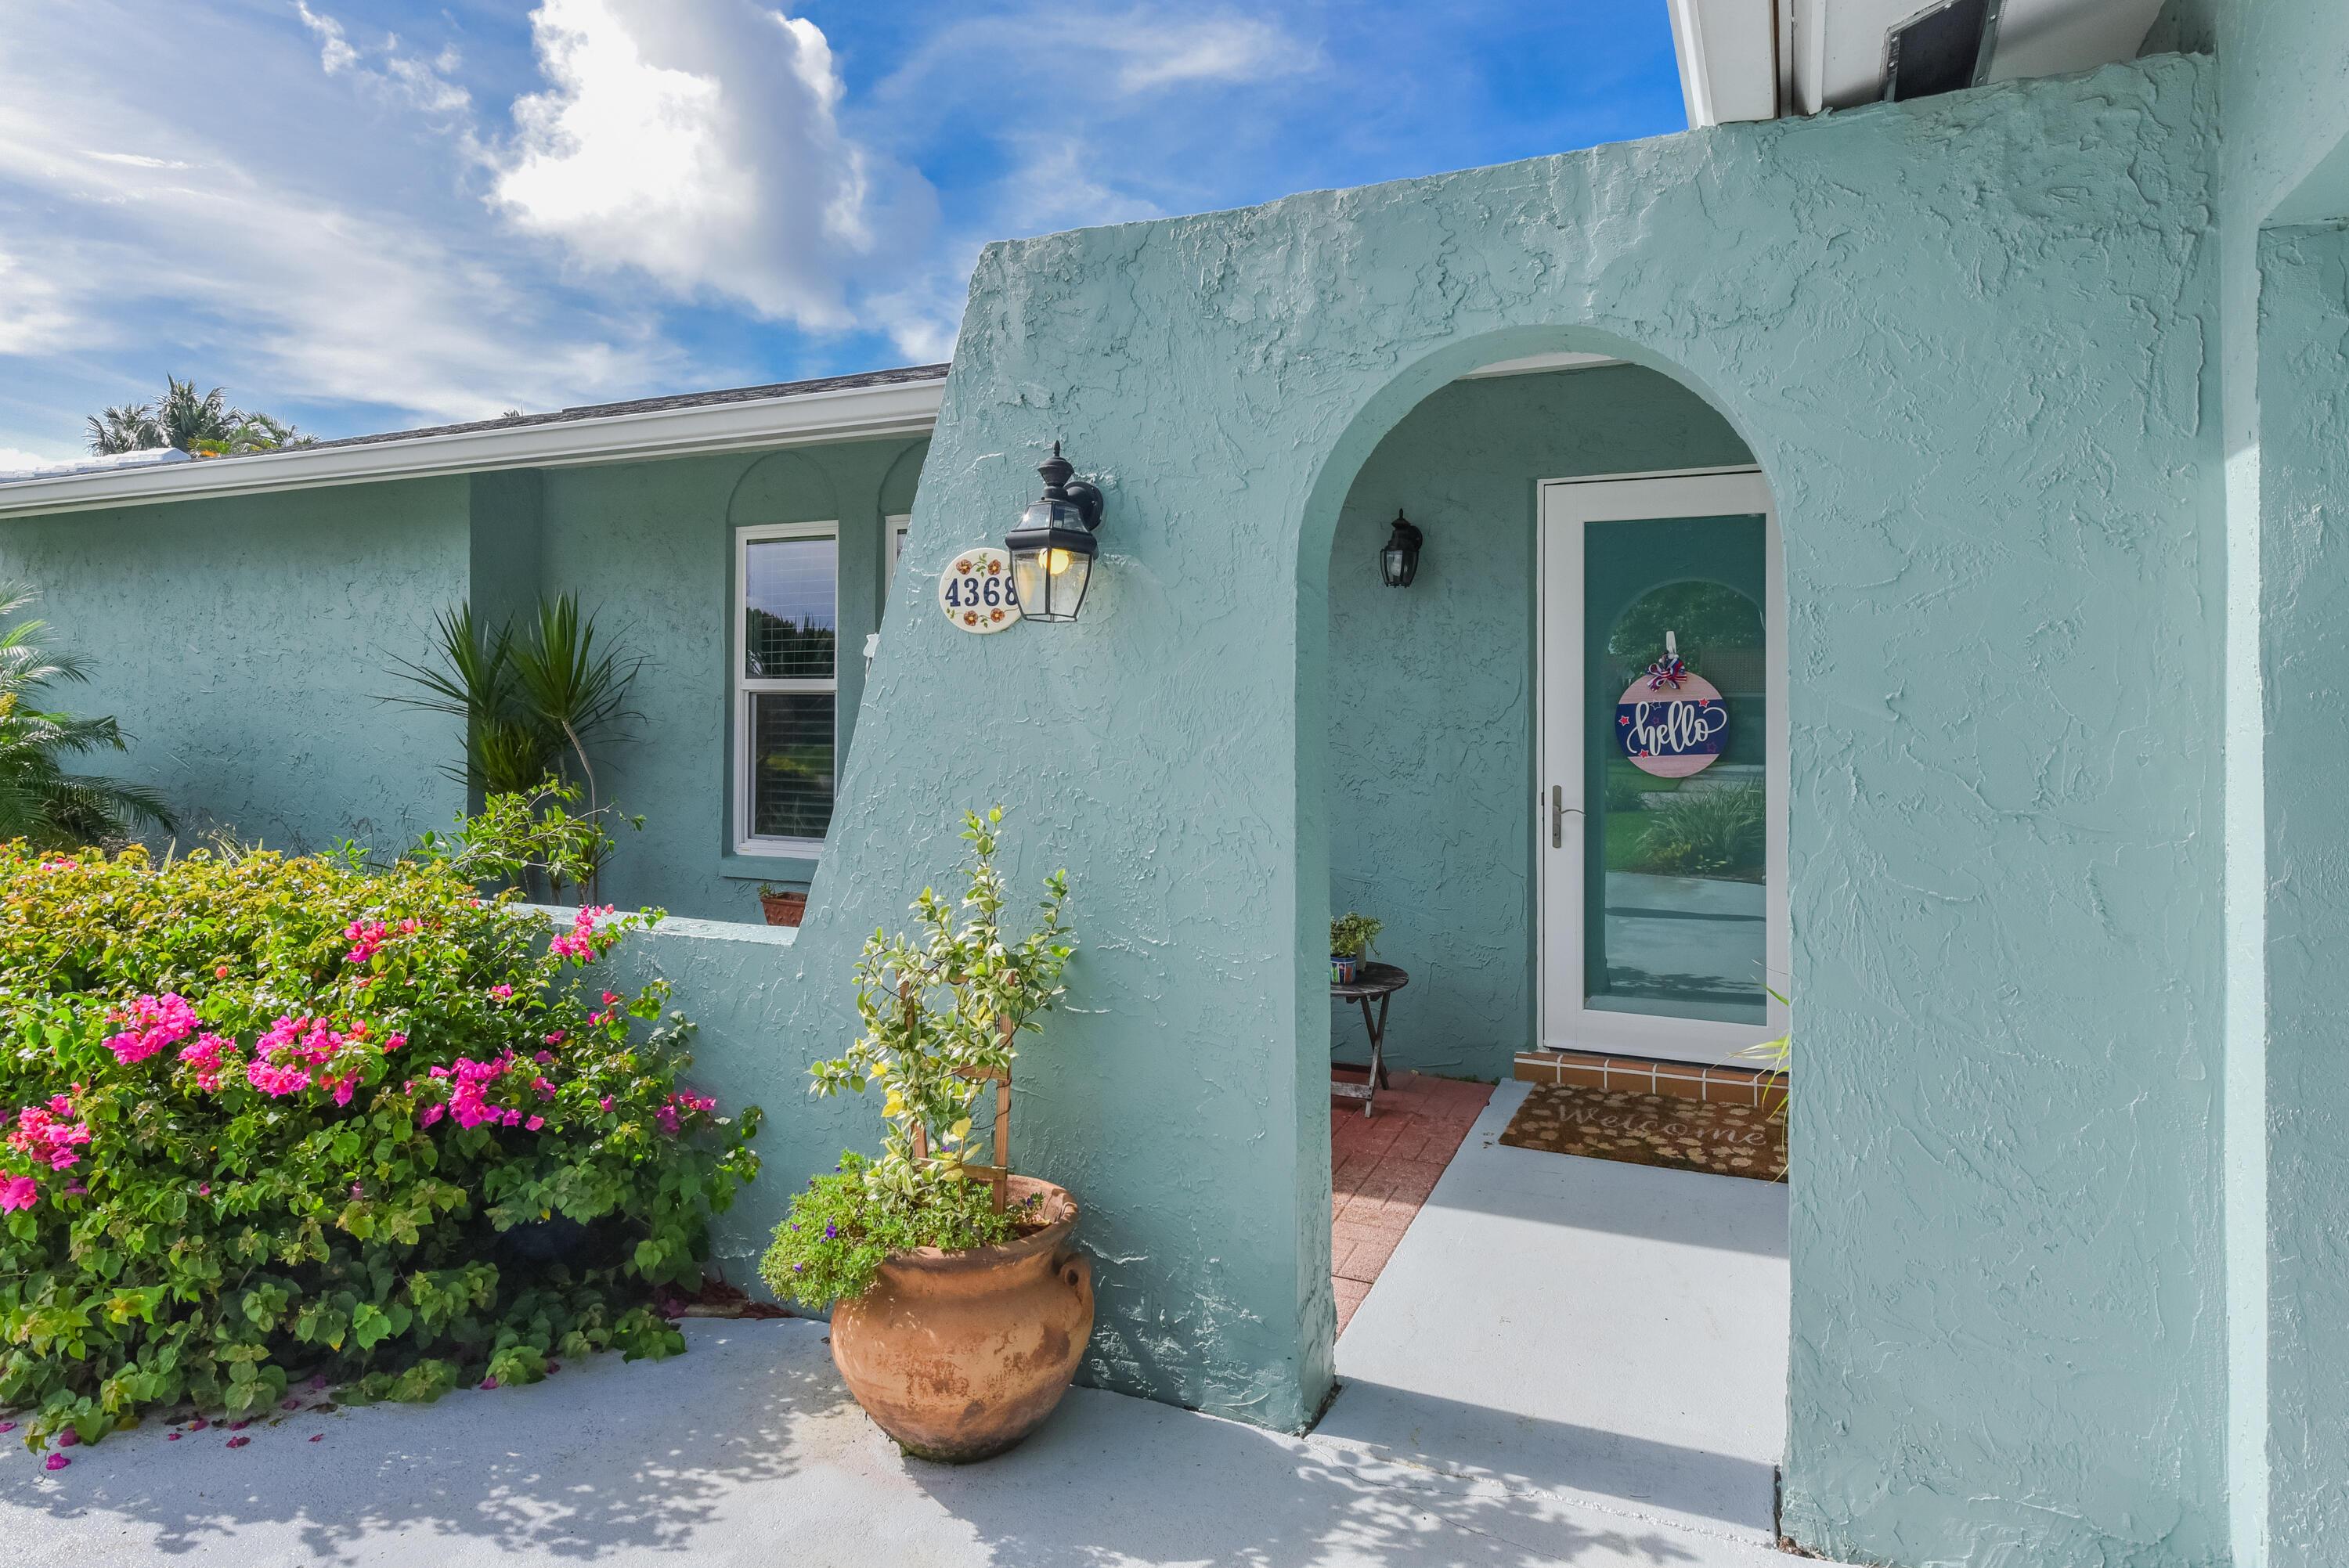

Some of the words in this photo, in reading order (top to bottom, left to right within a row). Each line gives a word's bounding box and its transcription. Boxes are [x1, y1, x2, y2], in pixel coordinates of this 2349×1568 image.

[945, 576, 1018, 607] 4368
[1626, 701, 1727, 756] hello
[1559, 1104, 1767, 1146] Welcome
